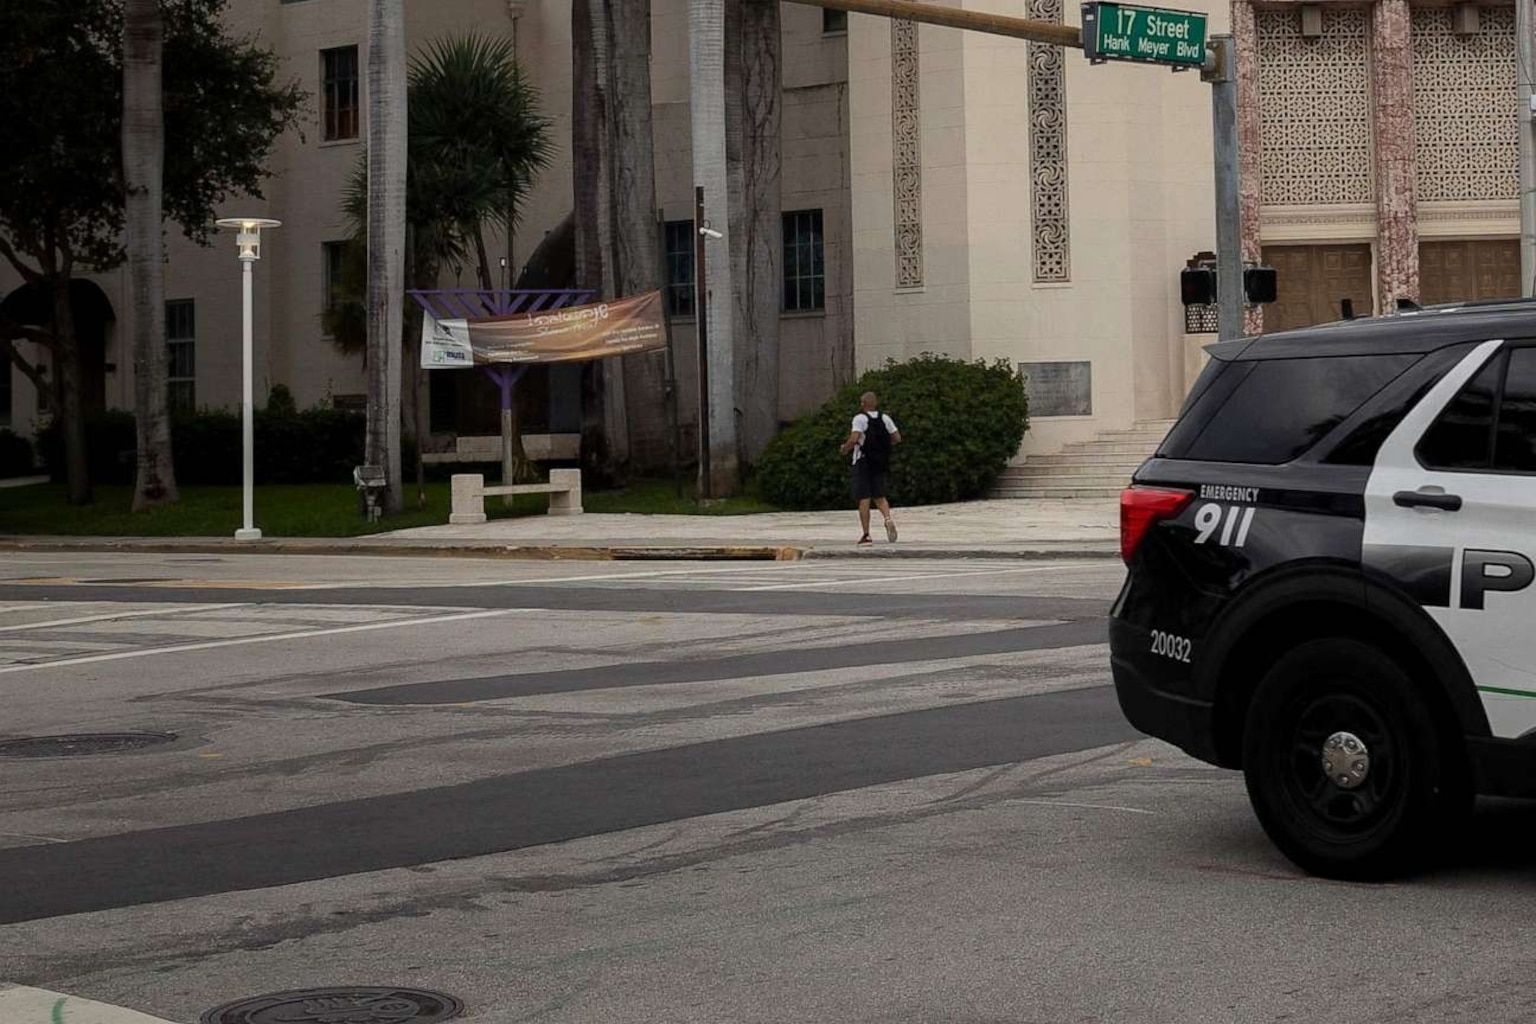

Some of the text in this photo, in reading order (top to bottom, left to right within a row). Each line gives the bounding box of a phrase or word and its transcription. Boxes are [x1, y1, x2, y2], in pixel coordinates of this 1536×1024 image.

[1116, 10, 1190, 40] 17 Street
[1103, 33, 1200, 59] Hank Meyer Blvd
[1200, 484, 1260, 503] EMERGENCY
[1193, 503, 1256, 548] 911
[1150, 629, 1192, 663] 20032
